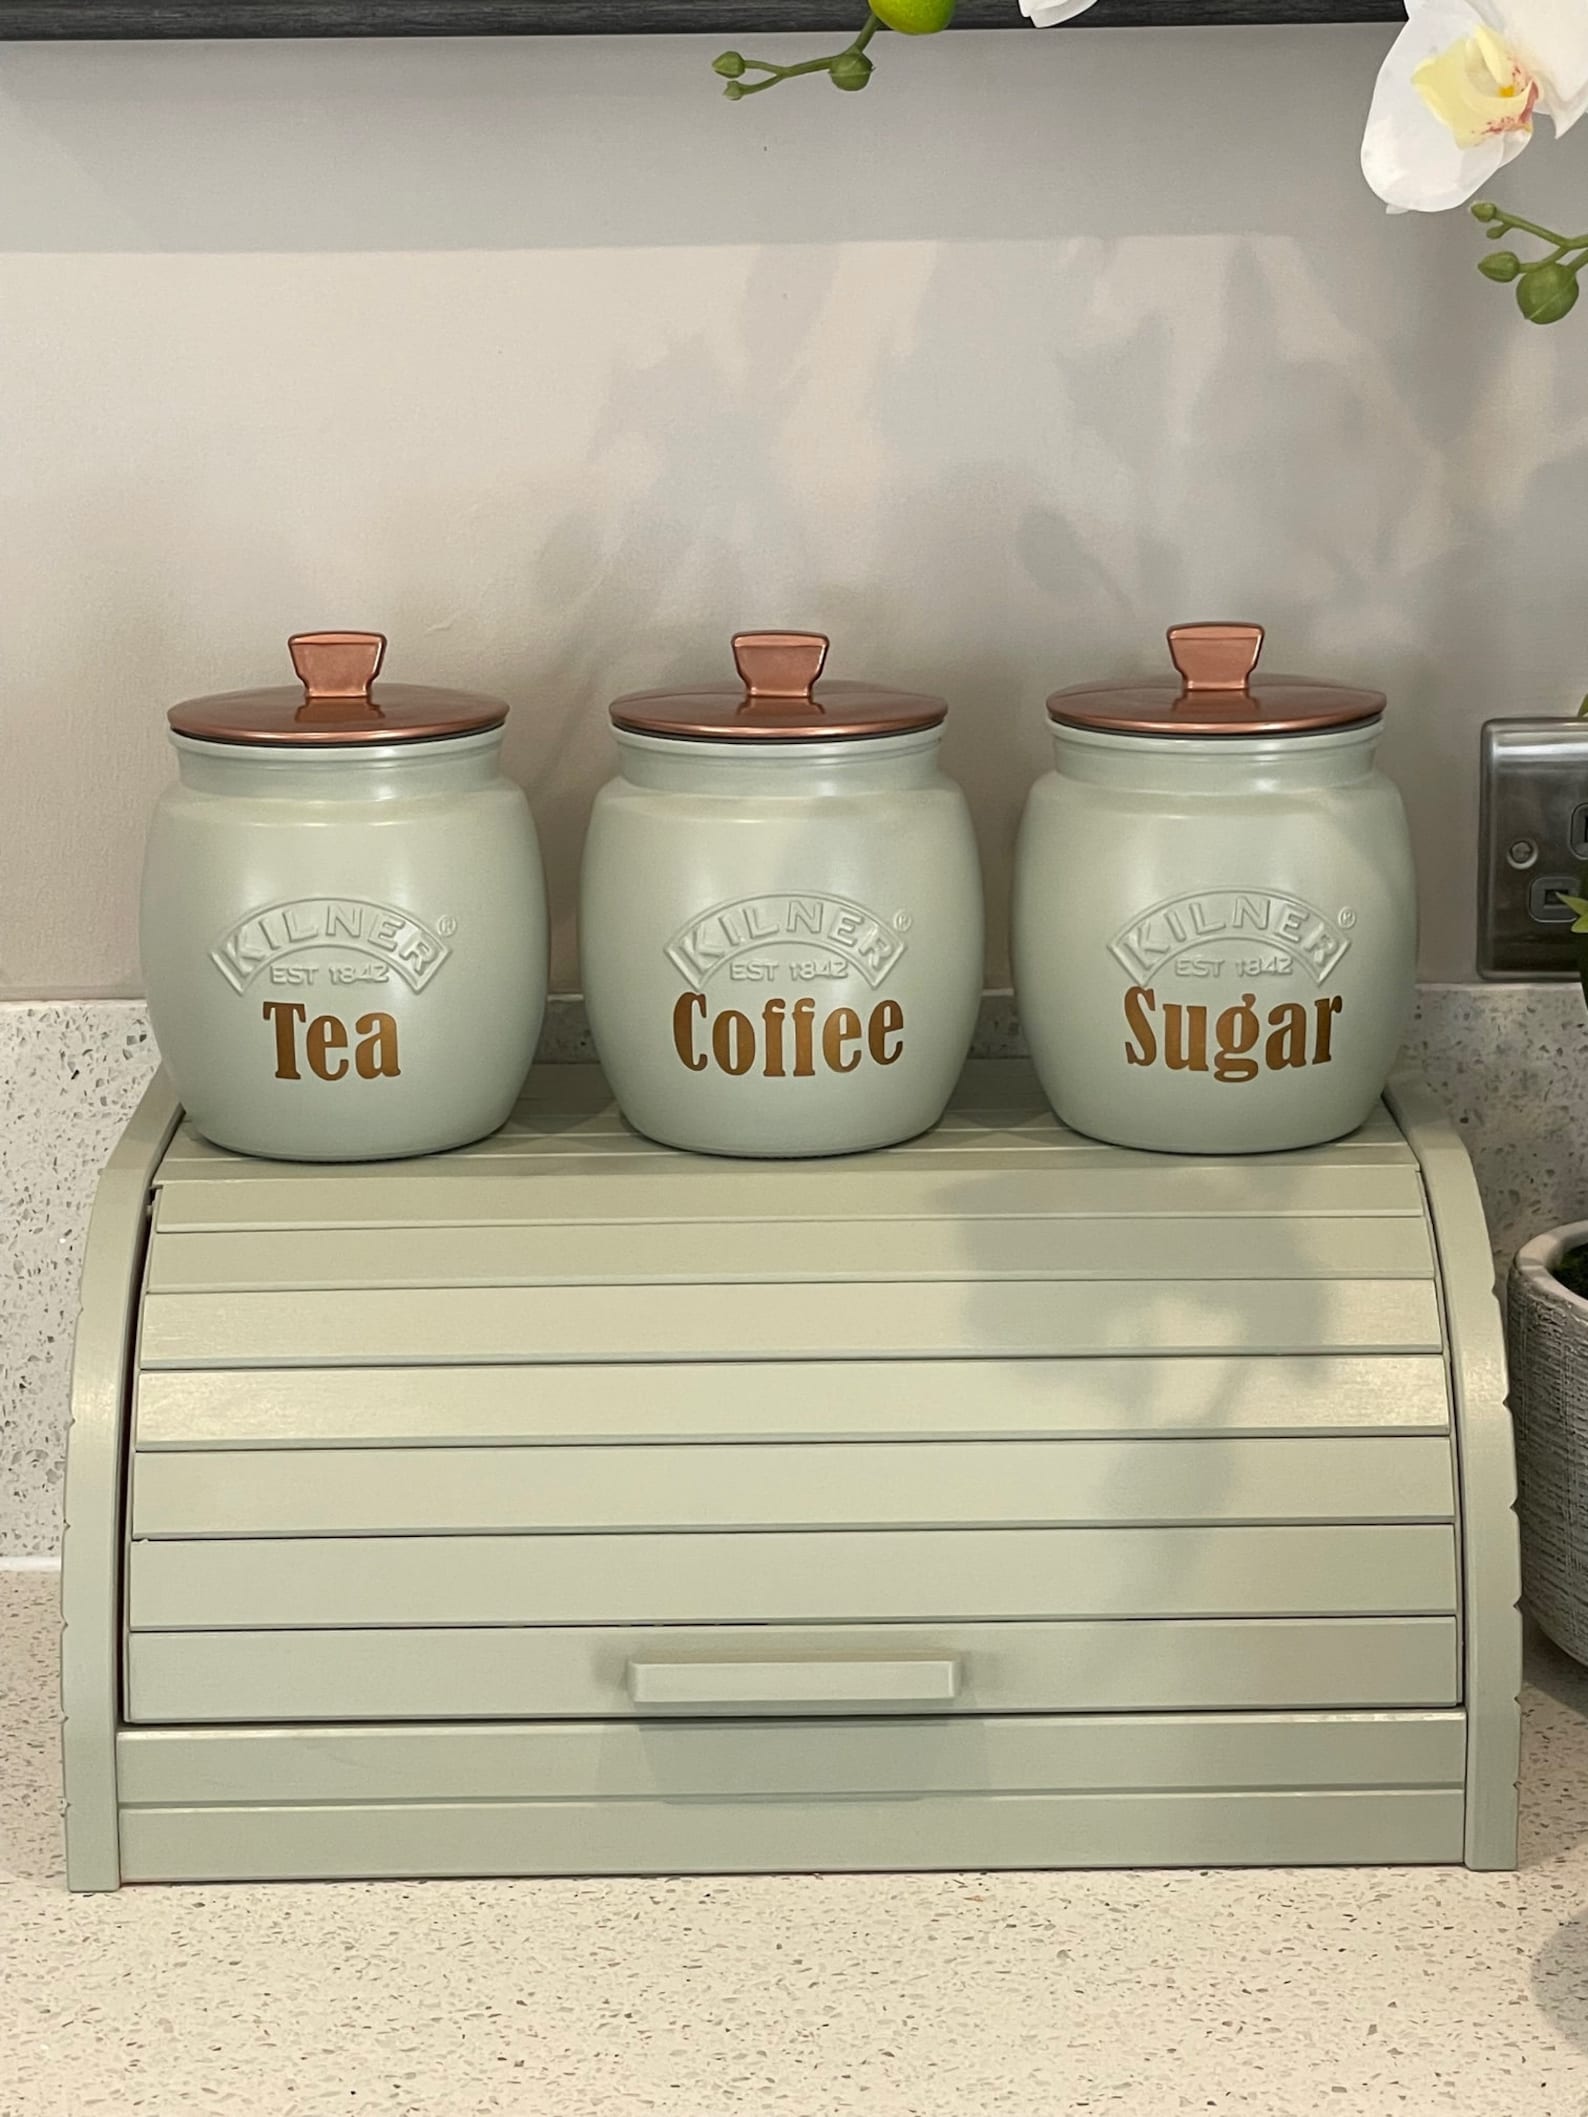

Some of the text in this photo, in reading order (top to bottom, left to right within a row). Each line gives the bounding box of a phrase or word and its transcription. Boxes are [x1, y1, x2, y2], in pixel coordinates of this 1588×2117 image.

[226, 904, 439, 977] KILNER
[680, 900, 896, 973] KILNER
[1123, 896, 1340, 971] KILNER
[1175, 956, 1293, 977] EST 1842
[270, 963, 389, 985] EST 1842
[729, 960, 848, 981] EST 1842
[263, 1001, 401, 1081] Tea
[673, 992, 904, 1077] Coffee
[1124, 986, 1343, 1083] Sugar
